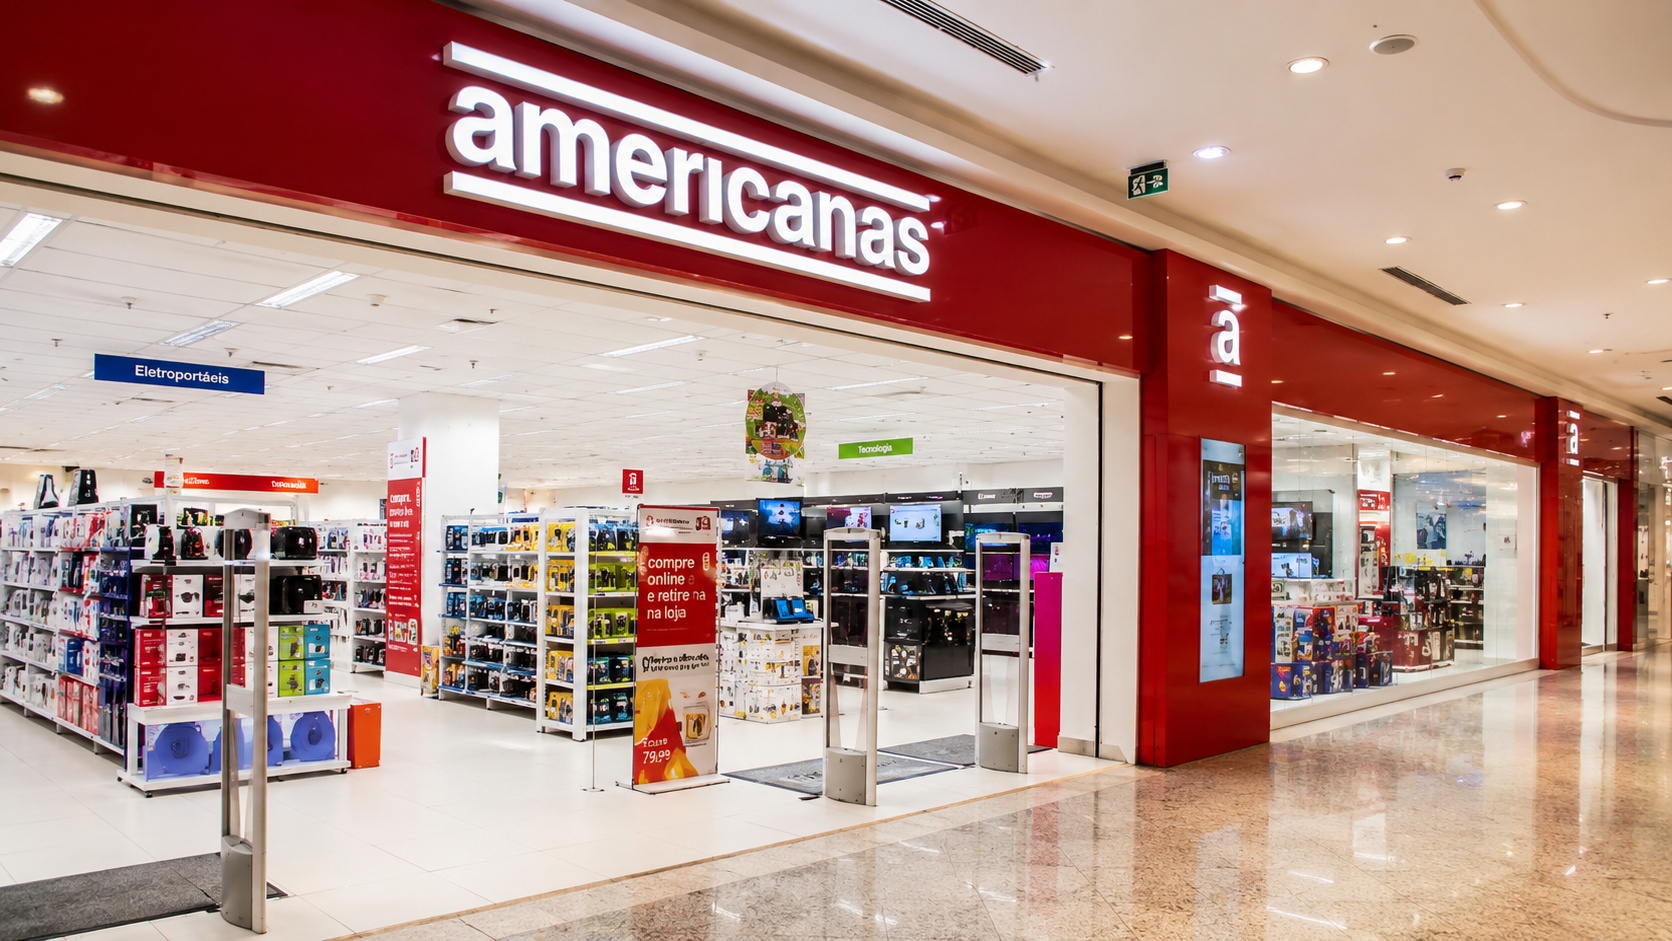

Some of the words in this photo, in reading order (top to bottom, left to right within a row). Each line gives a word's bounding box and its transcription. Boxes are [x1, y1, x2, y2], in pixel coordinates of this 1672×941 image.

[445, 85, 931, 277] americanas
[134, 364, 230, 384] Eletroportáeis
[857, 442, 893, 454] Tecnologia
[647, 558, 695, 572] compre
[647, 571, 685, 586] online
[647, 591, 655, 602] e
[657, 587, 690, 602] retire
[692, 590, 706, 601] na
[647, 608, 662, 620] na
[664, 605, 687, 622] loja
